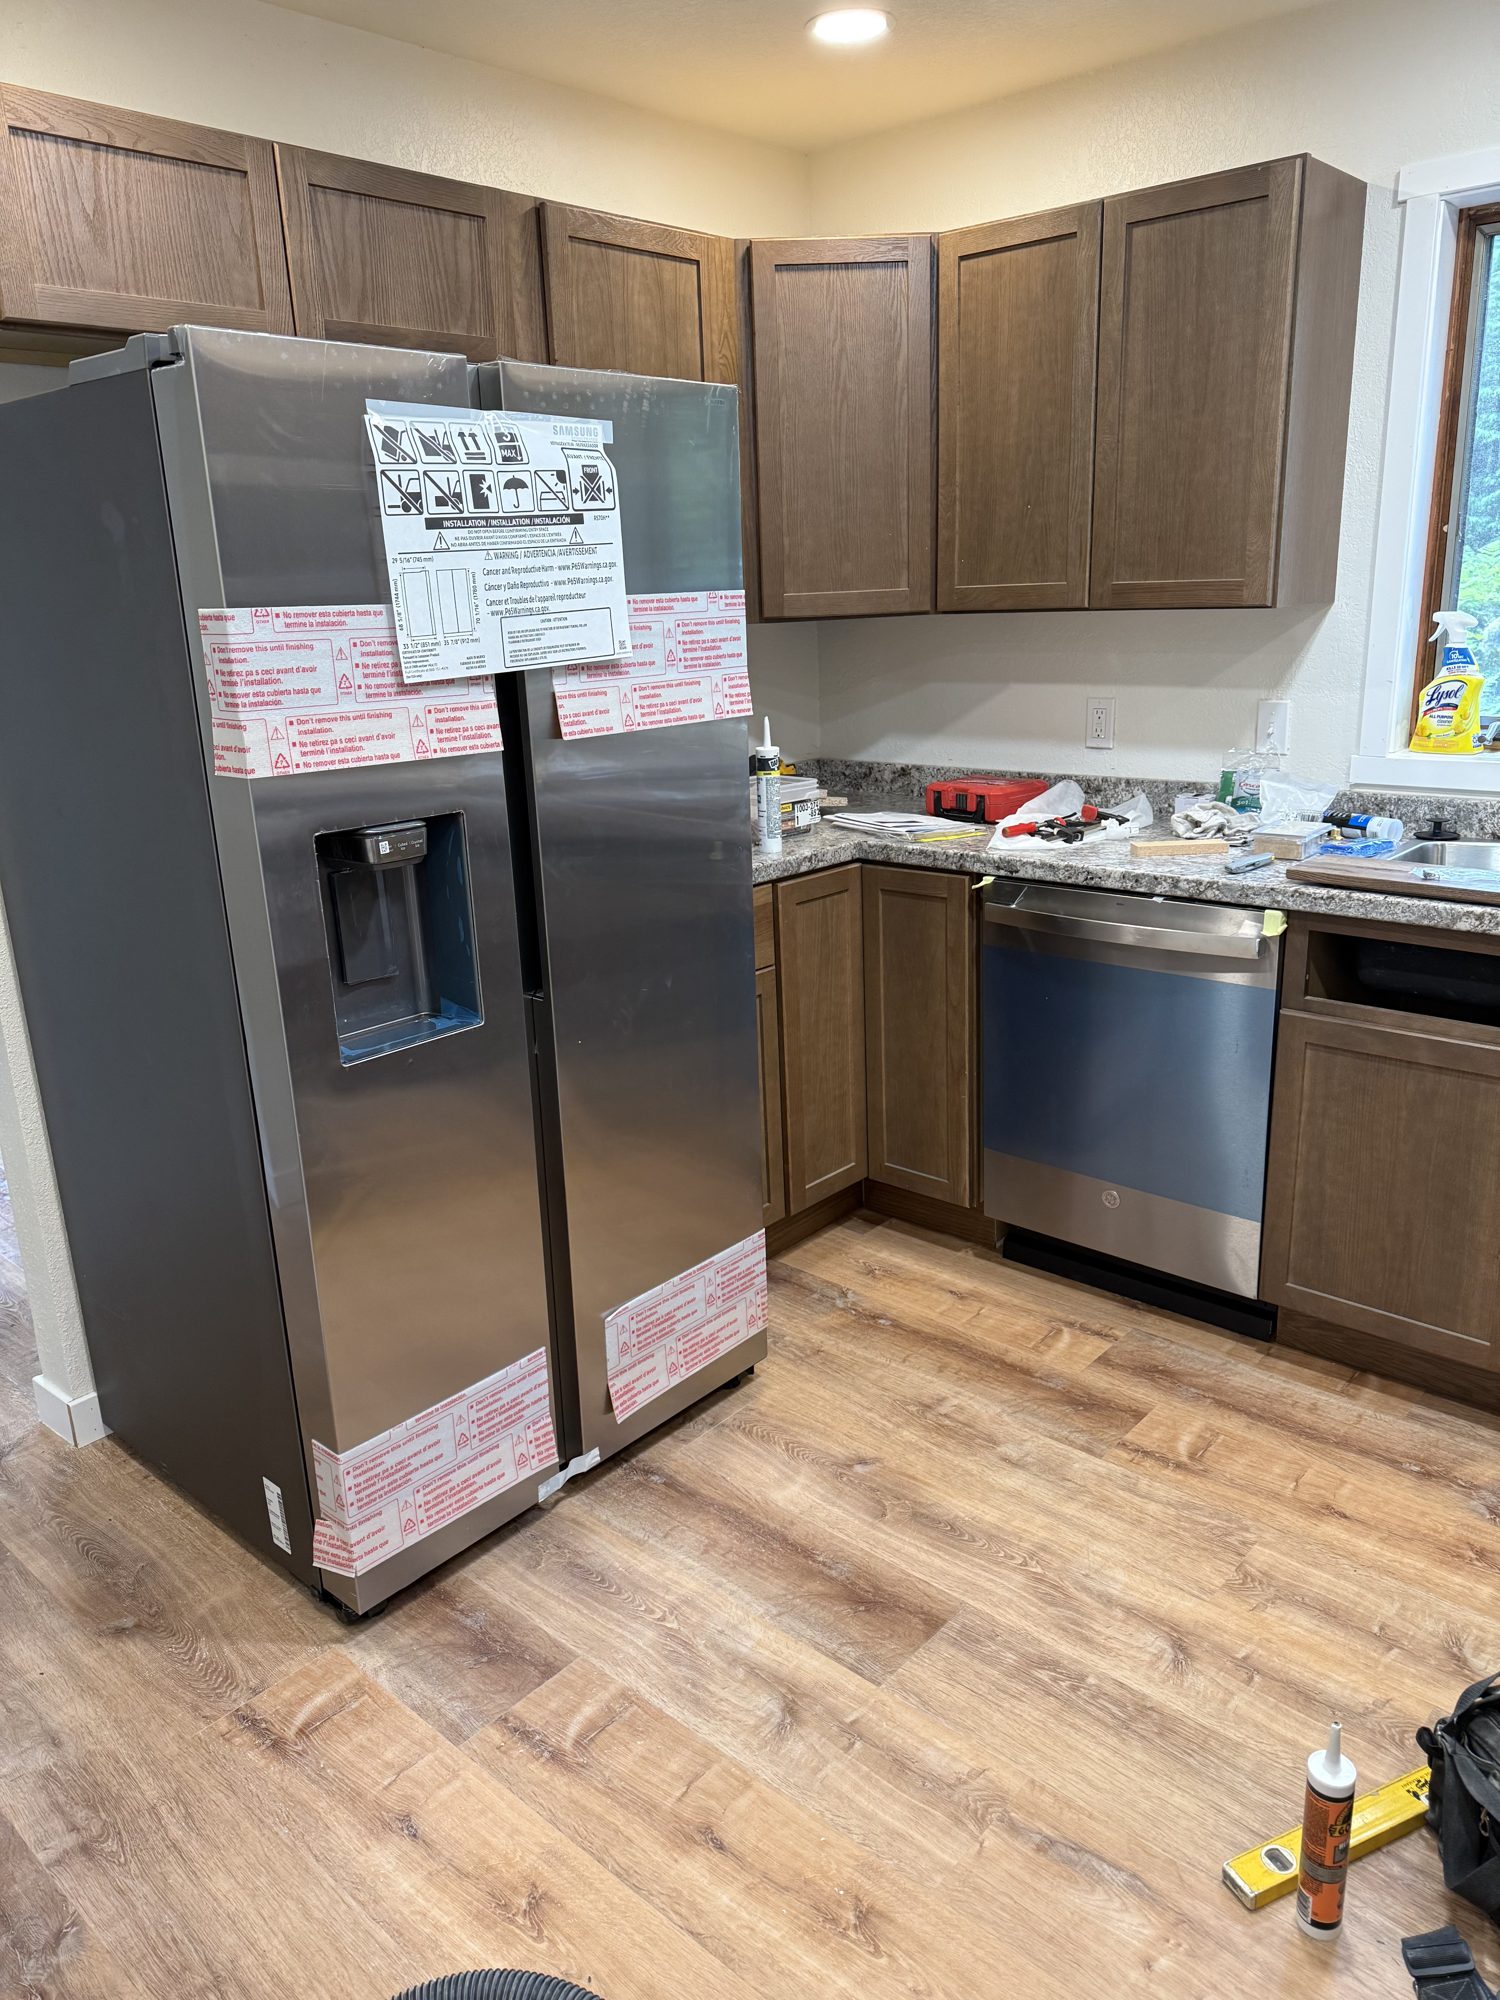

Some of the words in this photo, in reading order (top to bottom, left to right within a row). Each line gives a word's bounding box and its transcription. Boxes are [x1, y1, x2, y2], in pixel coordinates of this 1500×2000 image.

[552, 424, 599, 438] SAMSUNG
[501, 449, 516, 458] MAX
[583, 466, 598, 474] FRONT
[490, 518, 530, 526] INSTALLATION
[534, 515, 570, 524] INSTALACIÓN
[494, 551, 519, 560] WARNING
[502, 566, 511, 575] and
[511, 565, 541, 575] Reproductive
[484, 582, 502, 591] Cáncer
[520, 580, 549, 590] Reproductivo
[509, 596, 528, 604] Troubles
[556, 592, 586, 602] reproducteur
[286, 643, 314, 651] finishing
[266, 688, 292, 696] cubierta
[310, 688, 321, 696] que
[1426, 684, 1464, 706] Lysol
[296, 717, 314, 726] Don't
[353, 712, 365, 721] until
[366, 711, 392, 719] finishing
[297, 726, 334, 736] installation.
[309, 739, 329, 747] retirez
[345, 735, 357, 743] ceci
[358, 733, 375, 742] avant
[376, 732, 396, 740] d'avoir
[351, 754, 373, 763] cubierta
[374, 753, 389, 761] hasta
[390, 753, 400, 761] que
[352, 1461, 368, 1472] Don't
[369, 1450, 390, 1463] remove
